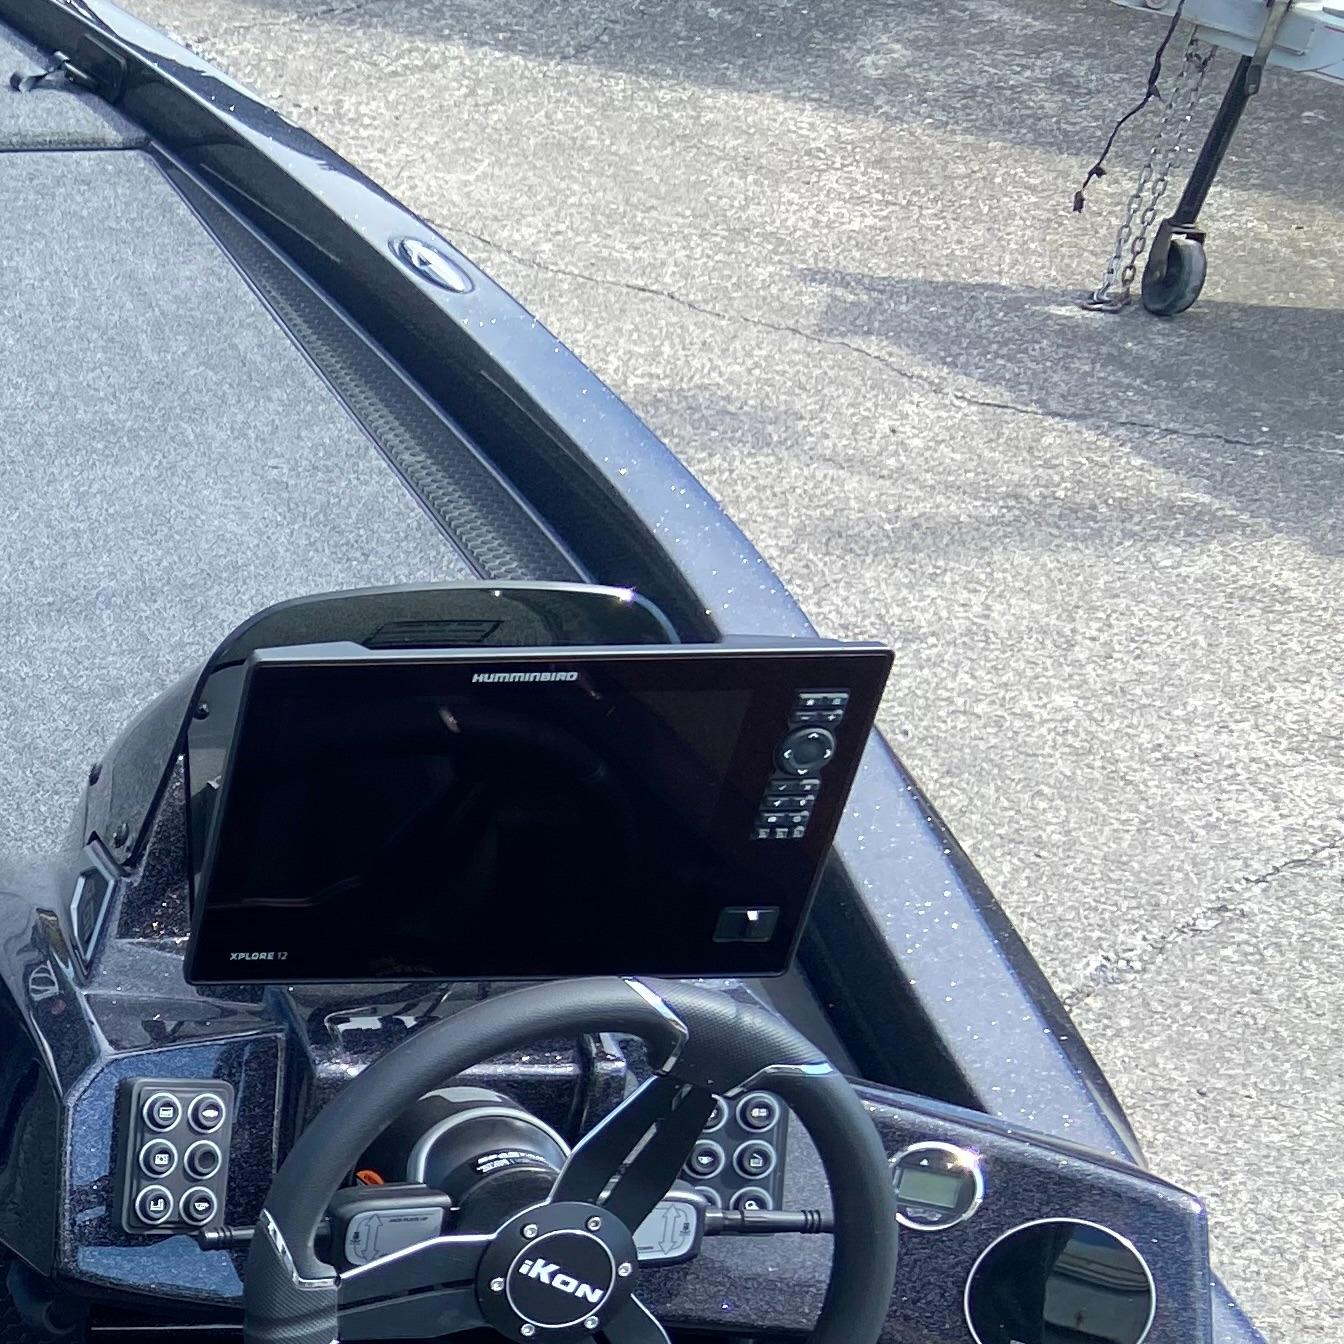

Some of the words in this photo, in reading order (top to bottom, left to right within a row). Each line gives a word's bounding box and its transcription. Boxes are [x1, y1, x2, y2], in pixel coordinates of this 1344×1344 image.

[472, 672, 578, 683] HUMMINBIRD
[230, 952, 274, 961] XPLORE
[277, 951, 289, 960] 12
